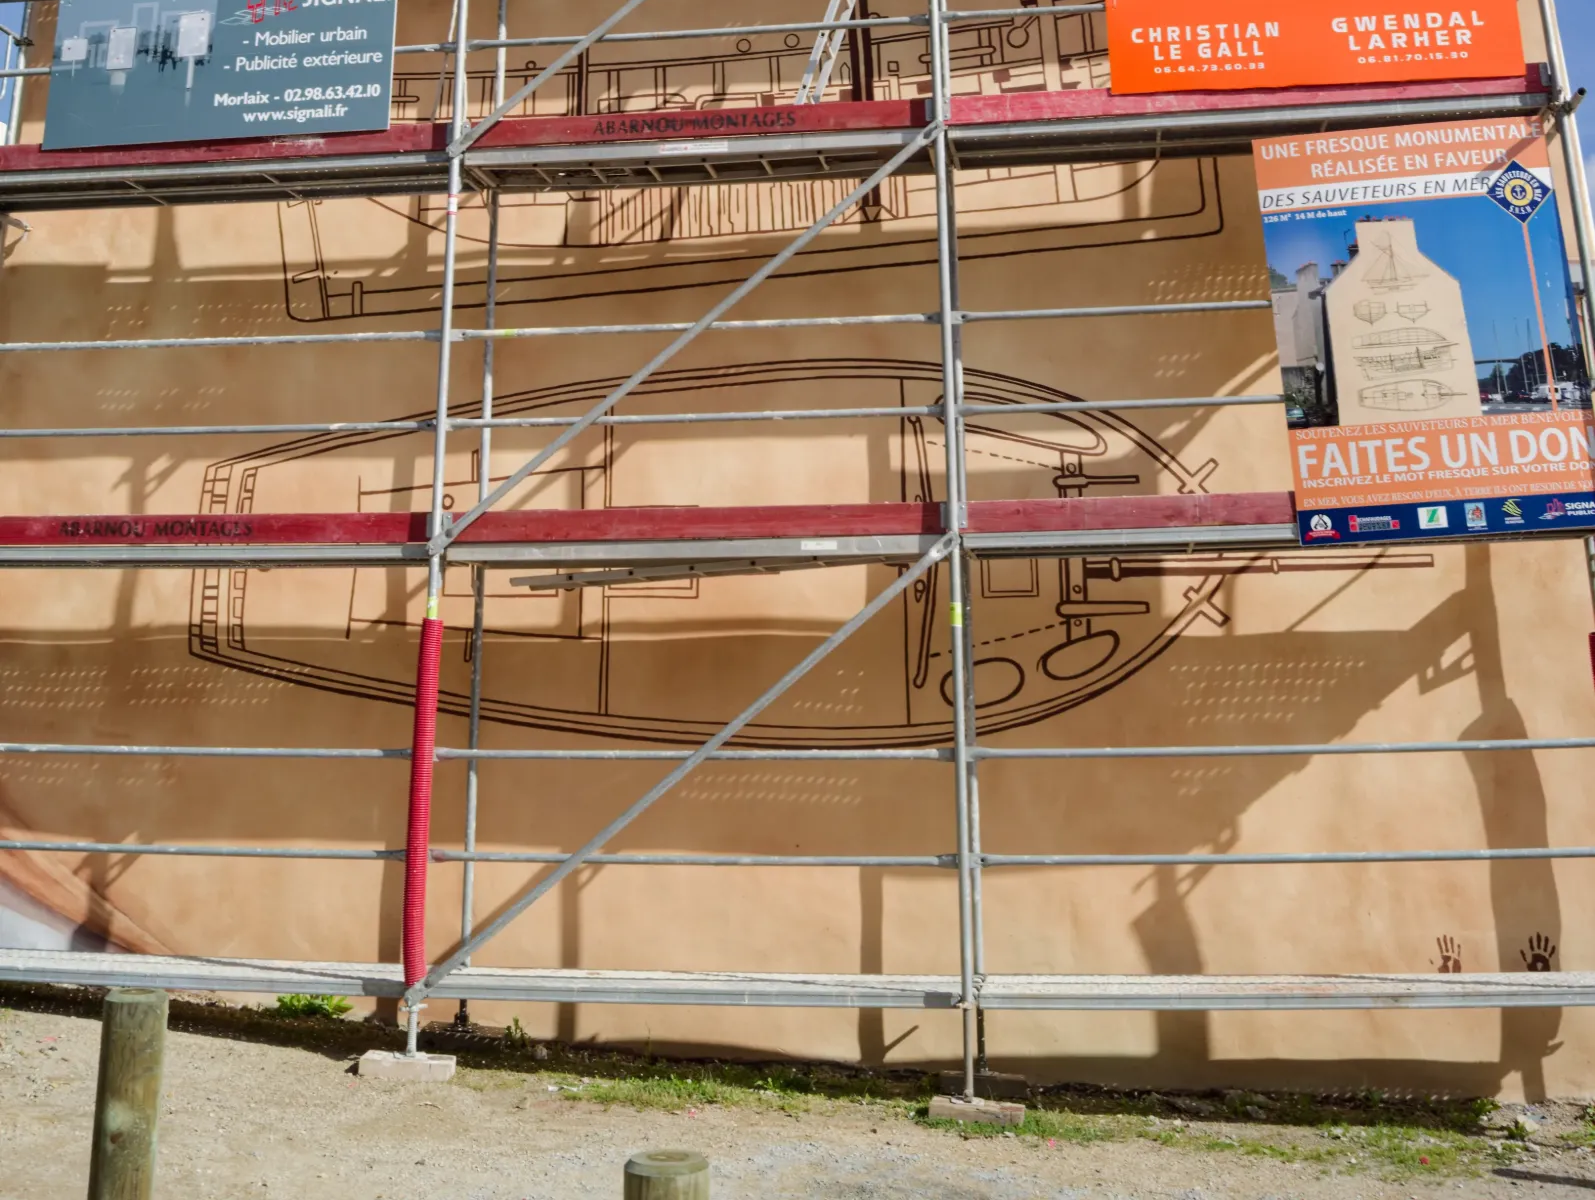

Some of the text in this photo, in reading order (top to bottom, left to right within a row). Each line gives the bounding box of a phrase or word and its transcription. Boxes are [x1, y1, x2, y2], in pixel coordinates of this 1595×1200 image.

[1131, 21, 1280, 44] CHRISTIAN
[1331, 10, 1485, 33] GWENDAL
[254, 29, 315, 47] Mobilier
[320, 26, 367, 42] urbain
[1348, 29, 1473, 51] LARHER
[235, 53, 298, 72] Publicité
[303, 51, 383, 67] extérieure
[1153, 40, 1264, 61] LE GALL
[213, 91, 270, 107] Morlaix
[284, 84, 381, 102] 02.98.63.42.10
[243, 104, 348, 123] www.signali.fr
[692, 111, 796, 131] MONTAGES
[1261, 123, 1541, 160] UNE FRESQUE MONUMENTALE
[1310, 148, 1508, 179] RÉALISÉE EN FAVEUR
[1262, 176, 1491, 209] DES SAUVETEURS EN MER
[1306, 211, 1315, 220] M
[1316, 210, 1326, 219] de
[1327, 209, 1347, 218] haut
[1296, 427, 1363, 441] SOUTENEZ
[1364, 423, 1388, 435] LES
[1389, 417, 1469, 433] SAUVETEURS
[1472, 416, 1490, 428] EN
[1490, 414, 1517, 427] MER
[1297, 425, 1595, 479] FAITES UN DON
[1303, 475, 1373, 488] INSCRIVEZ
[1376, 473, 1392, 484] LE
[1394, 471, 1425, 483] MOT
[1428, 467, 1489, 480] FRESQUE
[1492, 464, 1519, 476] SUR
[1522, 462, 1566, 474] VOTRE
[1303, 498, 1316, 508] EN
[1341, 494, 1365, 505] VOUS
[1367, 493, 1390, 503] AVEZ
[1391, 490, 1422, 502] BESOIN
[1464, 485, 1491, 496] TERRE
[1508, 483, 1528, 494] ONT
[1529, 481, 1561, 492] BESOIN
[1563, 480, 1578, 490] DE
